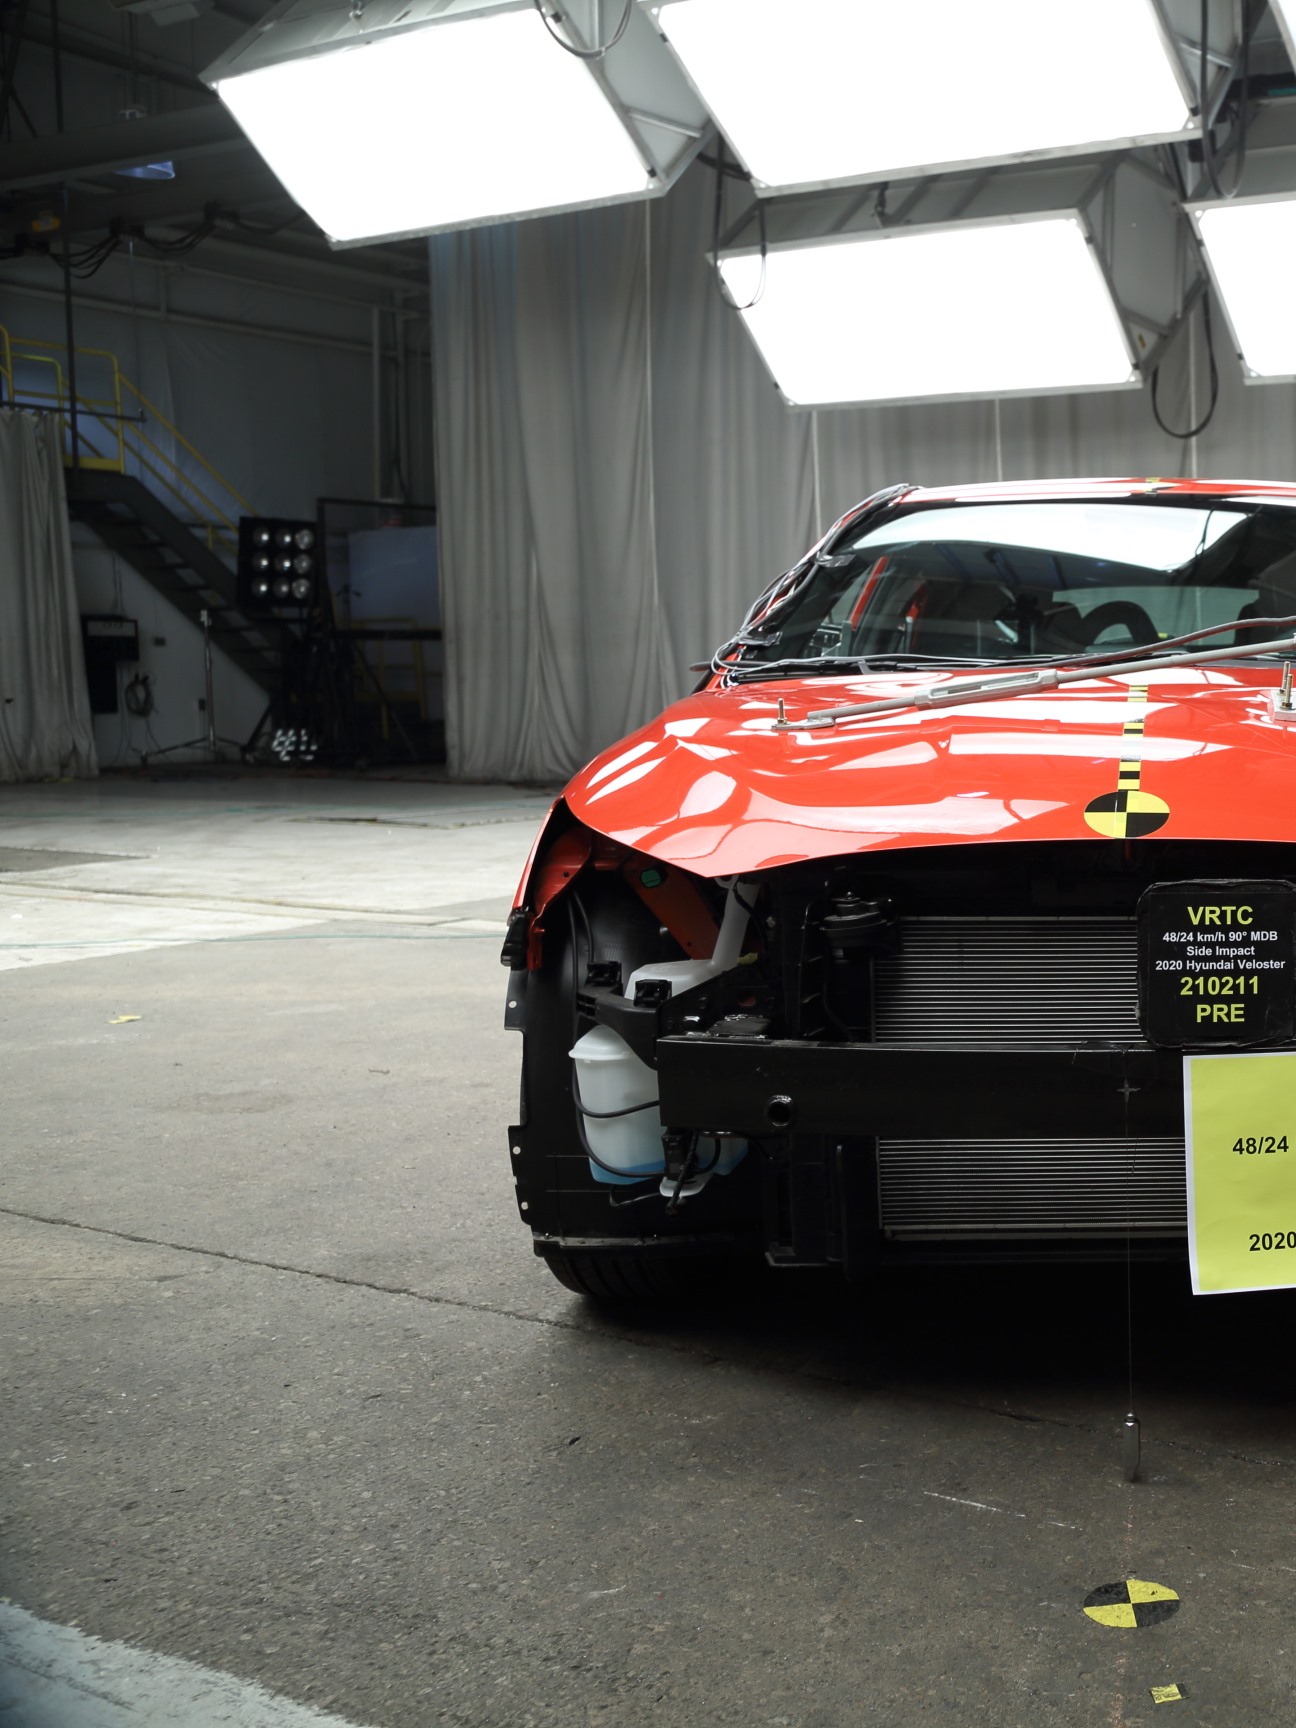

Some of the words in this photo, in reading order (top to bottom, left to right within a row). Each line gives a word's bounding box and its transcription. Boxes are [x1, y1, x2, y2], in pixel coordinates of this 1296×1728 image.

[1187, 906, 1253, 925] VRTC
[1162, 931, 1194, 942] 48/24
[1198, 931, 1225, 942] km/h
[1229, 931, 1248, 942] 90°
[1251, 931, 1278, 941] MDB
[1187, 946, 1213, 956] Side
[1216, 946, 1256, 957] Impact
[1155, 960, 1183, 971] 2020
[1186, 959, 1234, 972] Hyundai
[1238, 959, 1286, 970] Veloster
[1181, 976, 1258, 995] 210211
[1197, 1004, 1245, 1022] PRE
[1233, 1135, 1290, 1155] 48/24
